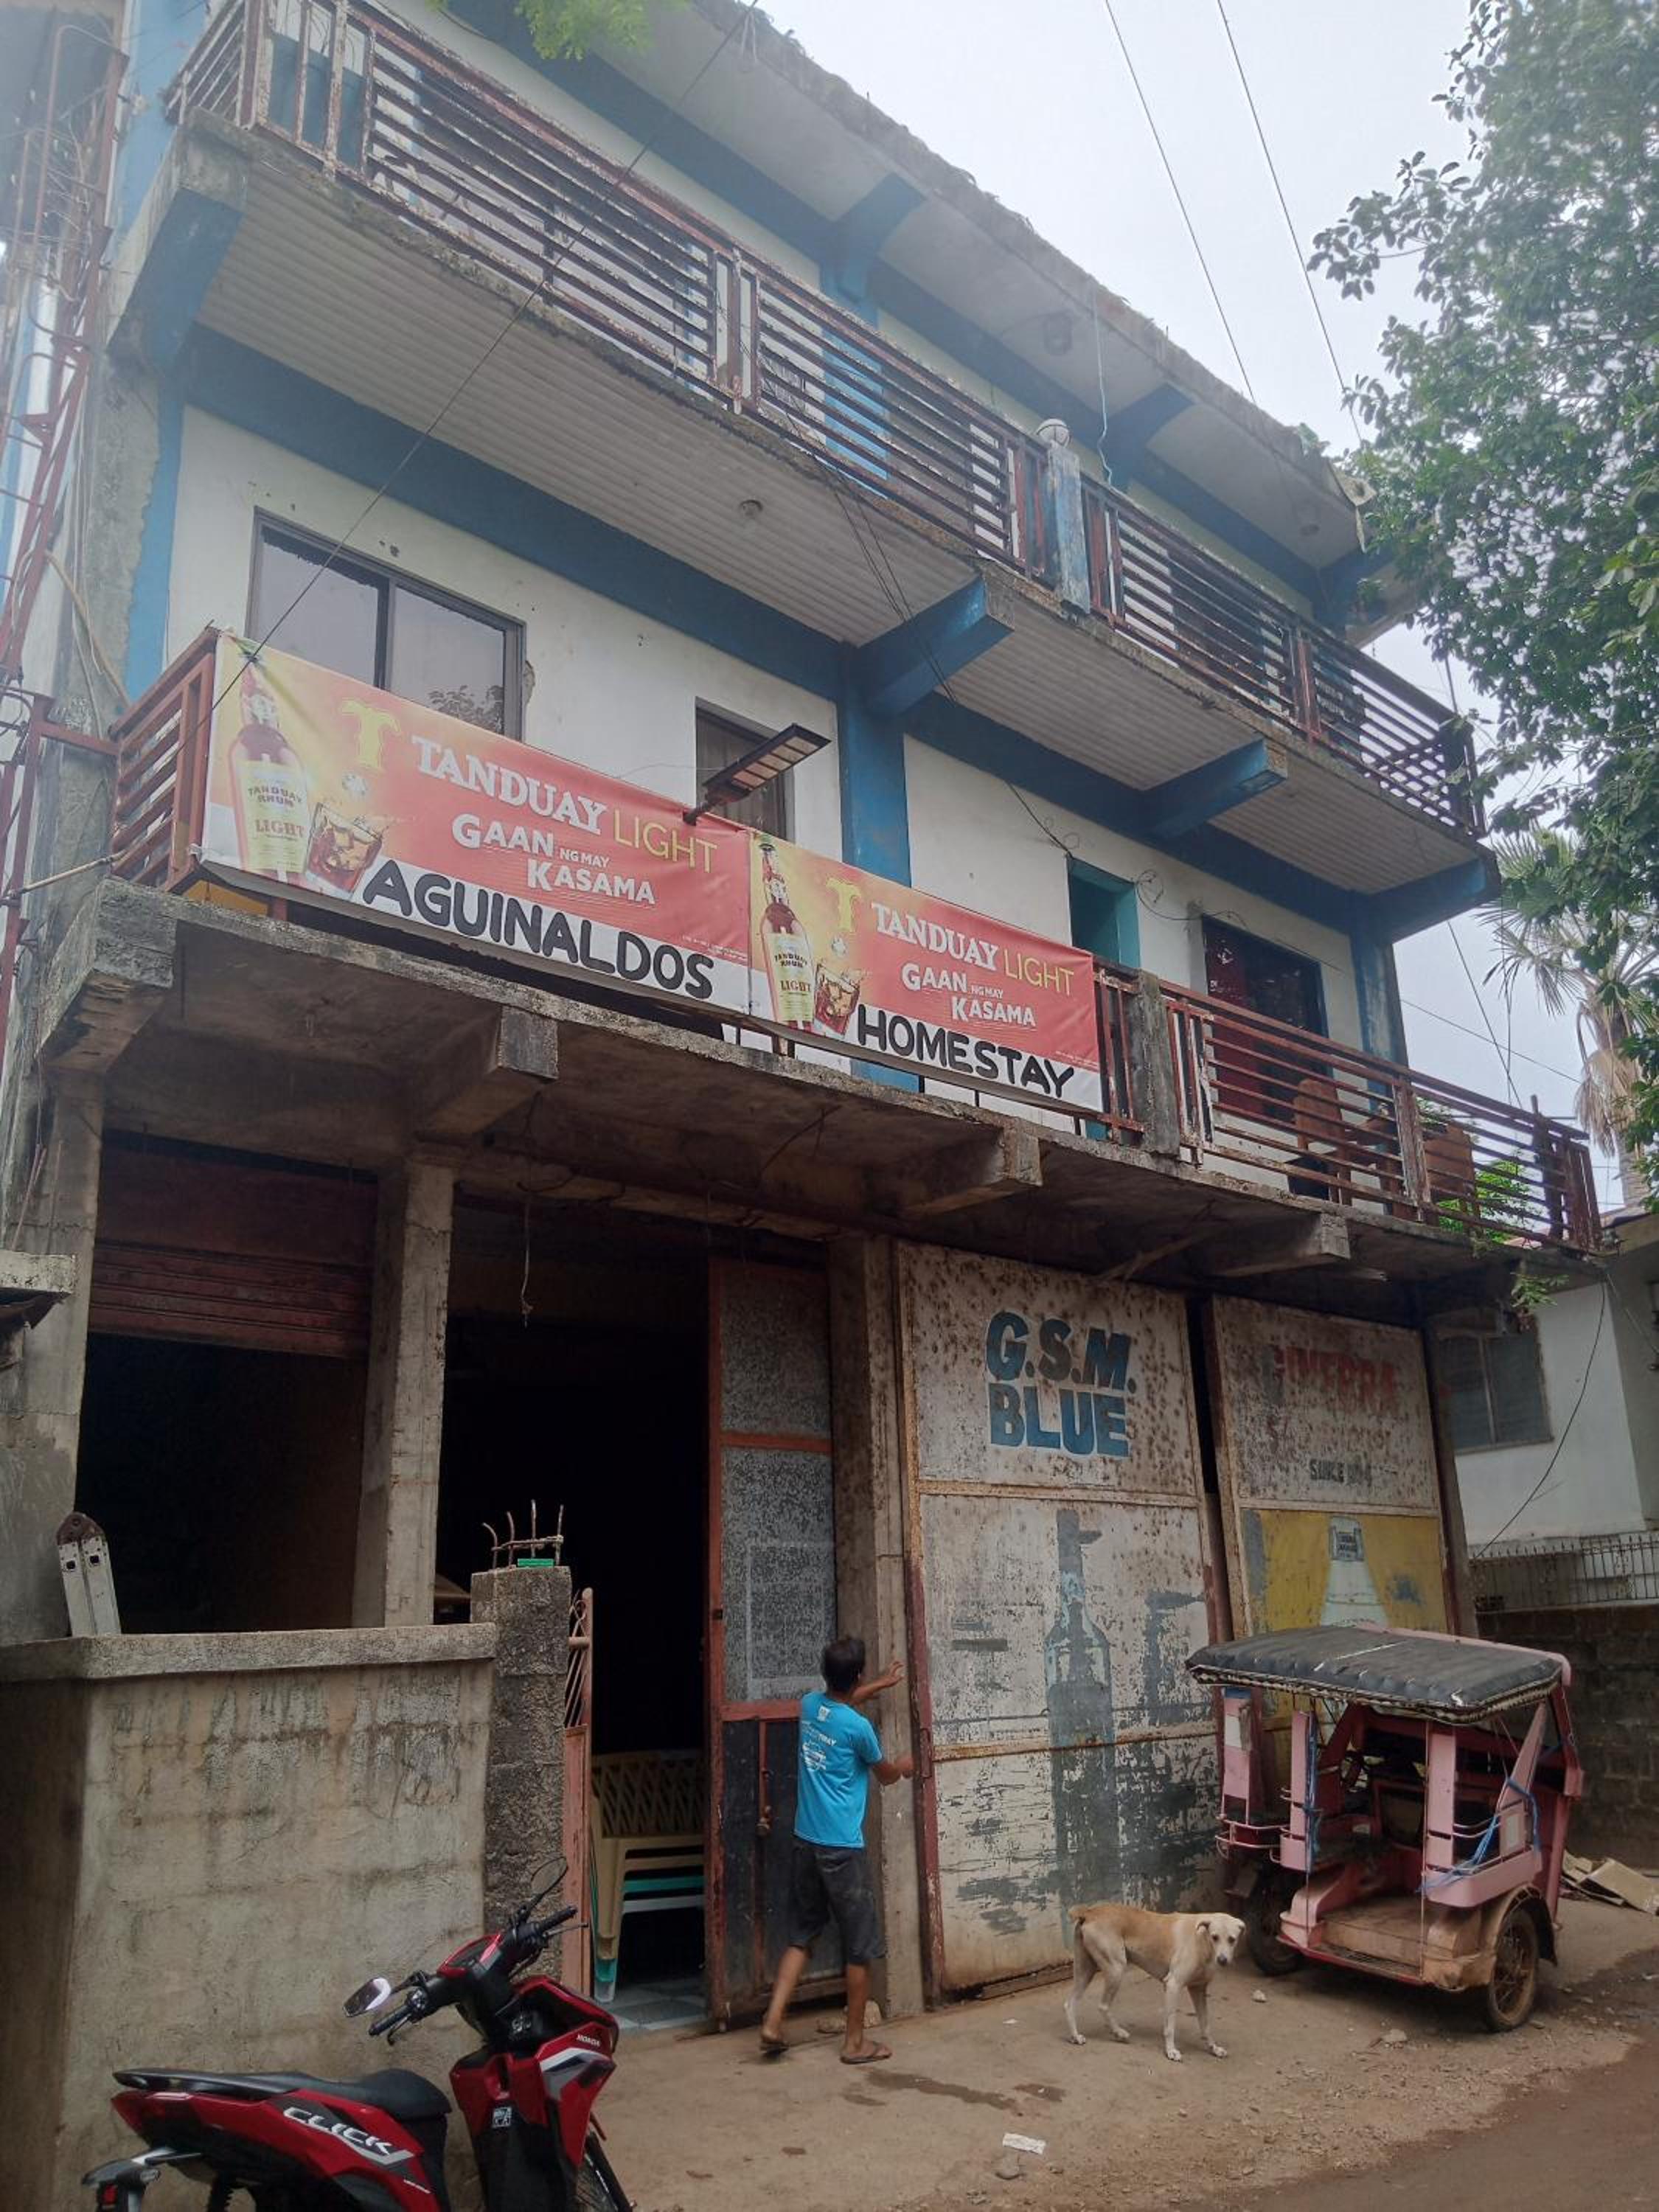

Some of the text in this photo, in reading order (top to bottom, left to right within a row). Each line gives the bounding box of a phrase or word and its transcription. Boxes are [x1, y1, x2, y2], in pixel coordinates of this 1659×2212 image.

[255, 819, 305, 838] LIGHT
[412, 735, 718, 874] TANDUAY LIGHT
[452, 813, 611, 869] GAAN NG MAY
[526, 858, 655, 905] KASAMA
[362, 859, 715, 1000] AGUINALDOS
[872, 902, 1075, 995] TANDUAY LIGHT
[780, 980, 811, 992] LIGHT
[902, 962, 968, 993] GAAN
[951, 996, 1036, 1026] KASAMA
[858, 1004, 1075, 1098] HOMESTAY
[985, 1311, 1137, 1394] G.S.M.
[990, 1383, 1130, 1458] BLUE
[283, 2107, 392, 2156] CLICK
